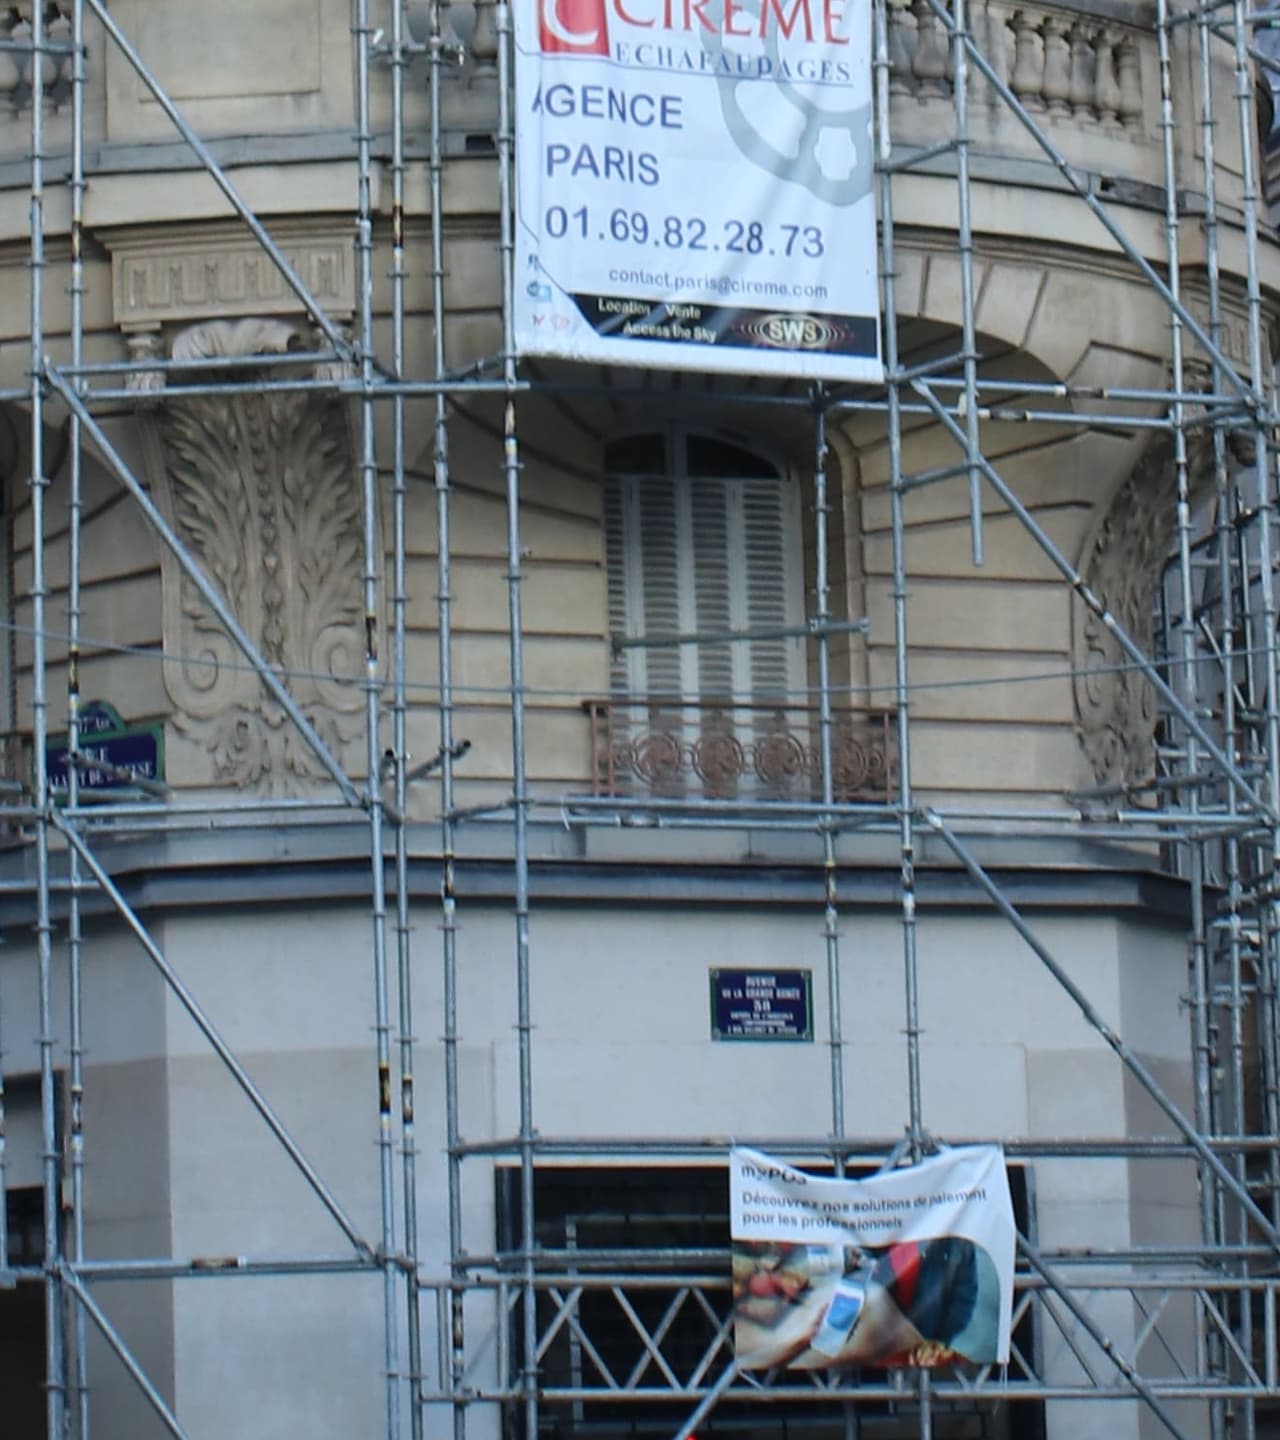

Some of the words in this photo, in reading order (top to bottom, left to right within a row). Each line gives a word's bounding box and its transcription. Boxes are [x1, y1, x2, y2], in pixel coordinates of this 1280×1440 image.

[616, 41, 852, 83] ECHAFAUDAGES
[531, 83, 684, 130] AGENCE
[545, 142, 661, 187] PARIS
[545, 204, 825, 259] 01.69.82.28.73
[608, 266, 829, 300] contact.paris@cireme.com
[598, 297, 651, 316] Location
[665, 303, 702, 320] Vente
[623, 321, 670, 339] Access
[693, 327, 718, 344] Sky
[769, 319, 819, 343] SWS
[742, 1190, 819, 1212] Découvrez
[822, 1201, 850, 1214] nos
[852, 1196, 911, 1214] solutions
[742, 1212, 776, 1228] pour
[778, 1213, 799, 1227] les
[800, 1214, 903, 1233] professionnels
